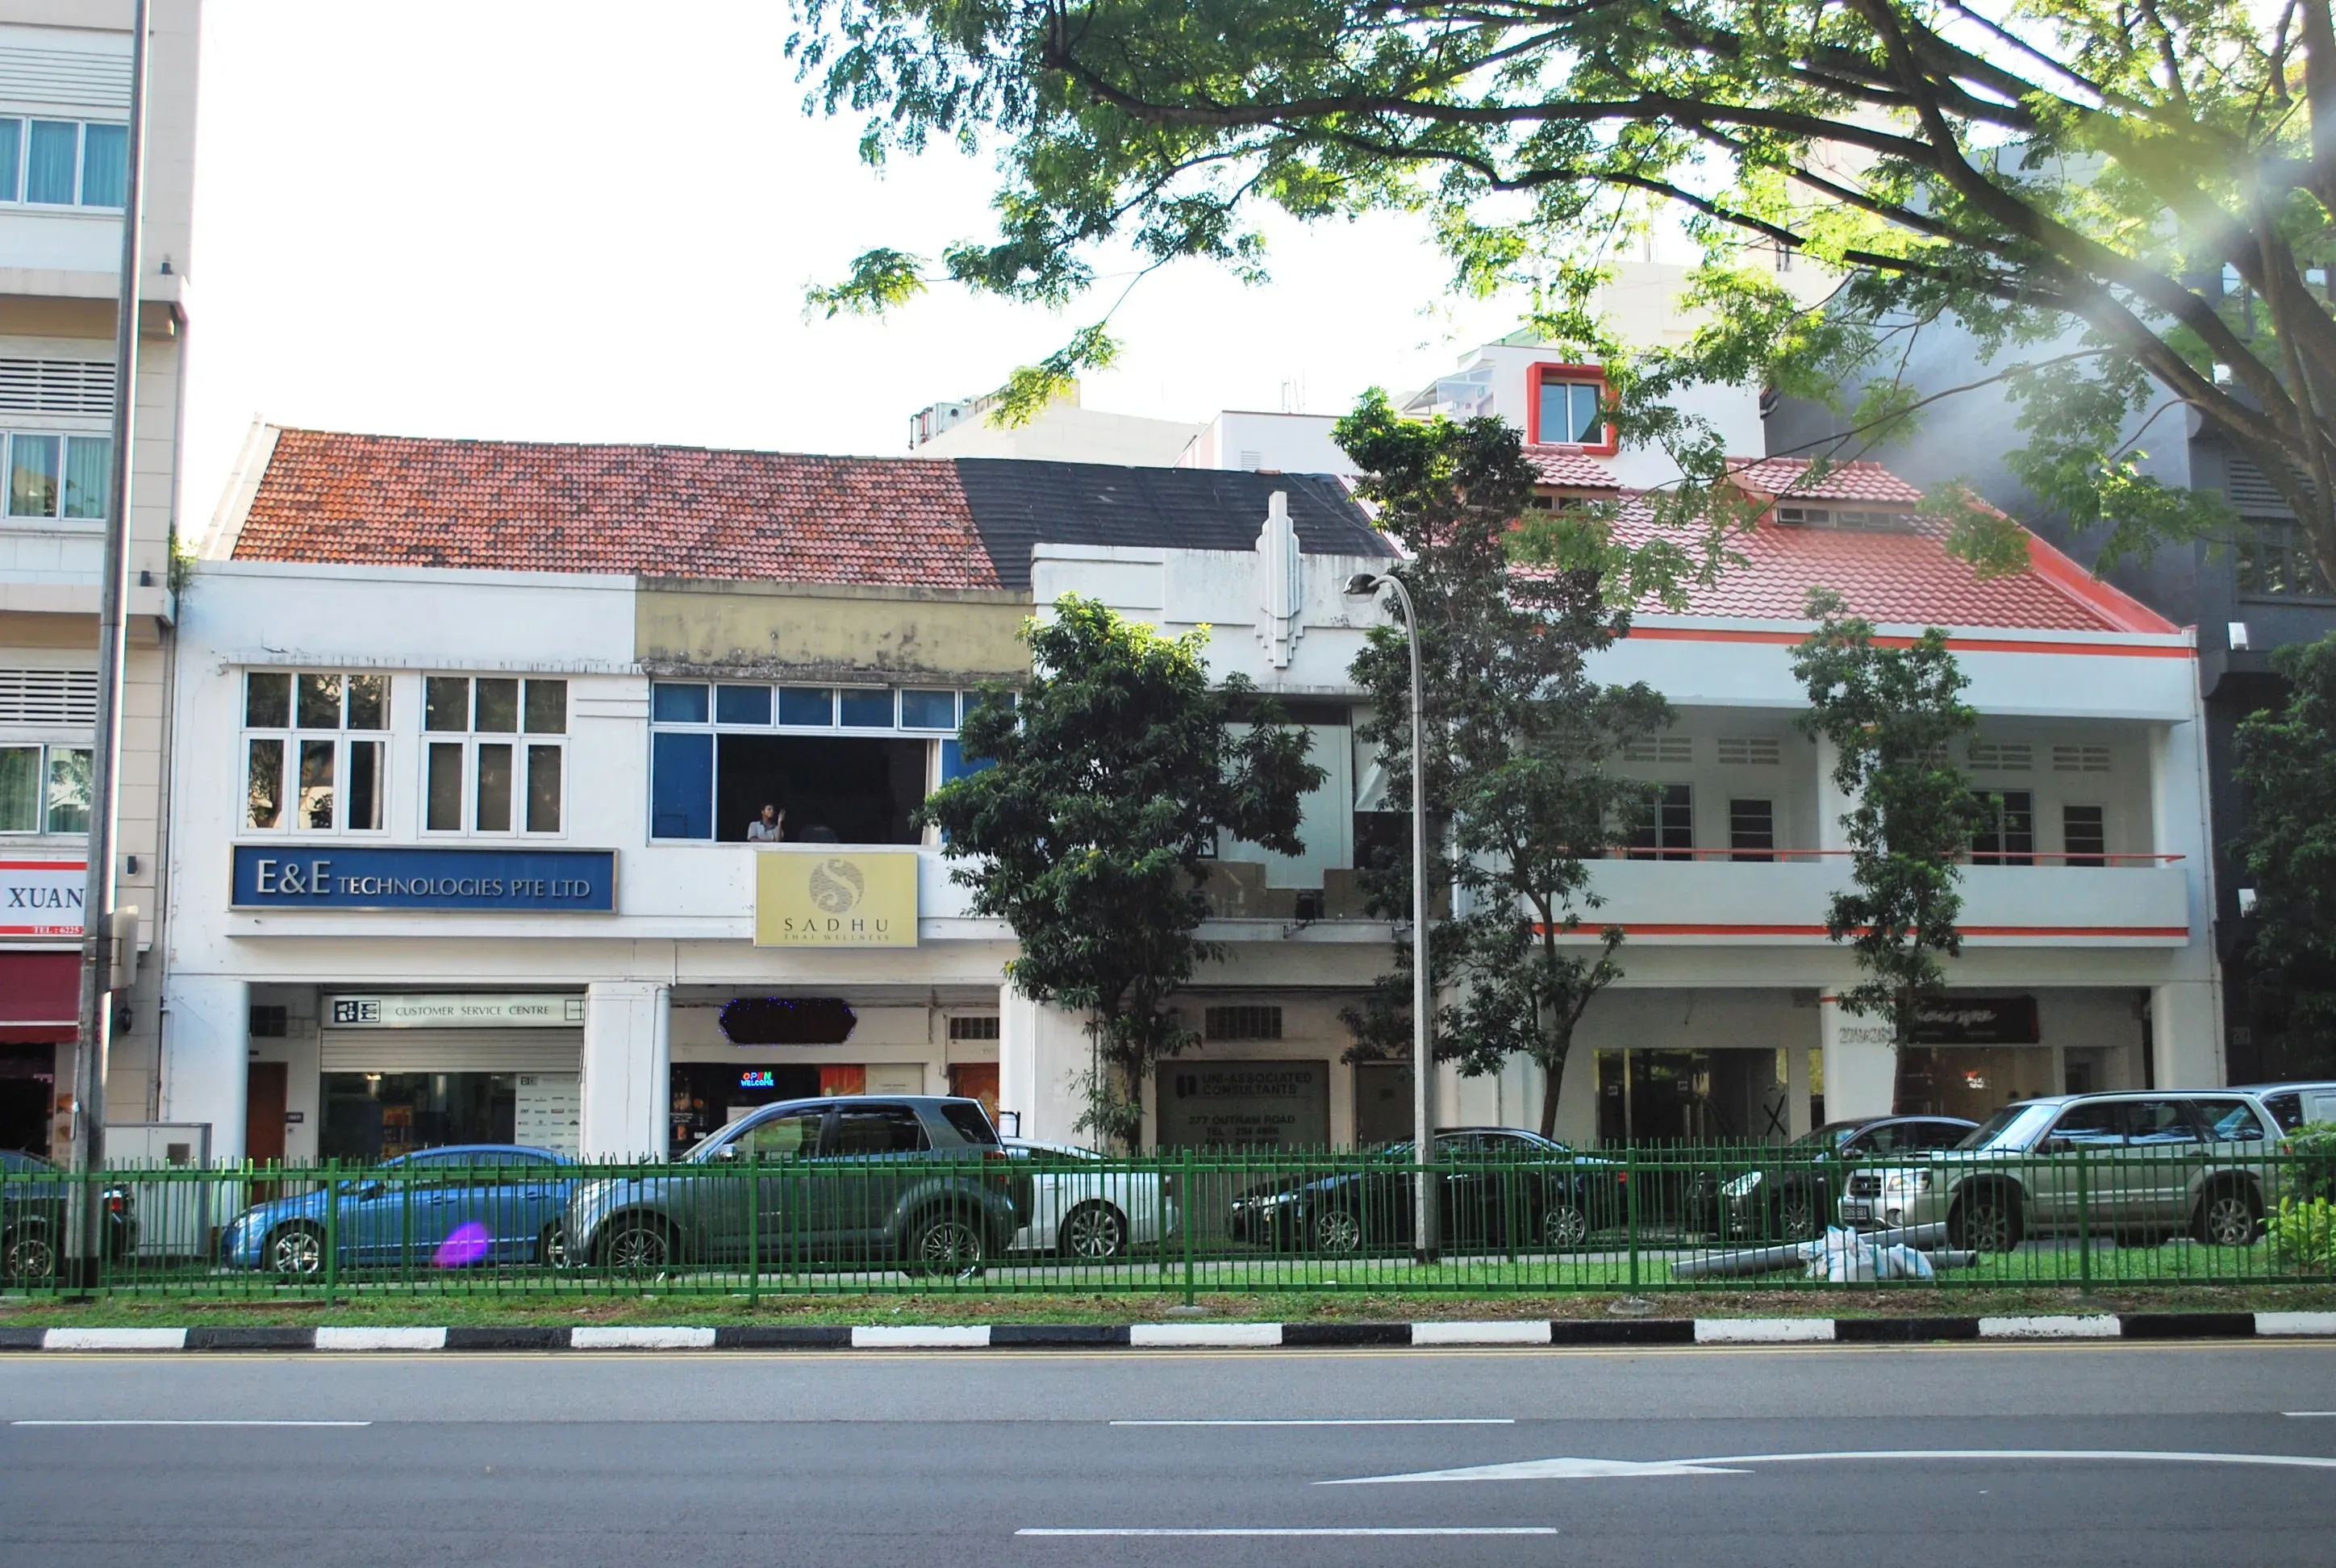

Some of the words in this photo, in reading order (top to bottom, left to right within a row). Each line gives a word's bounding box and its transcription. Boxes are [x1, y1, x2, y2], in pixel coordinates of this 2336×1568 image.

[257, 859, 332, 894] E&E
[336, 877, 503, 897] TECHNOLOGIES
[511, 879, 544, 897] PTE
[552, 879, 591, 898] LTD
[7, 887, 85, 908] XUAN
[34, 926, 52, 934] TEL
[60, 926, 80, 934] 6225
[784, 917, 888, 932] SADHU
[395, 1006, 454, 1016] CUSTOMER
[461, 1005, 502, 1015] SERVICE
[508, 1005, 549, 1015] CENTRE
[743, 1071, 772, 1080] OPEN
[1203, 1084, 1298, 1096] CONSULTANTS
[1212, 1115, 1261, 1124] OUTRAM
[1264, 1115, 1296, 1124] ROAD
